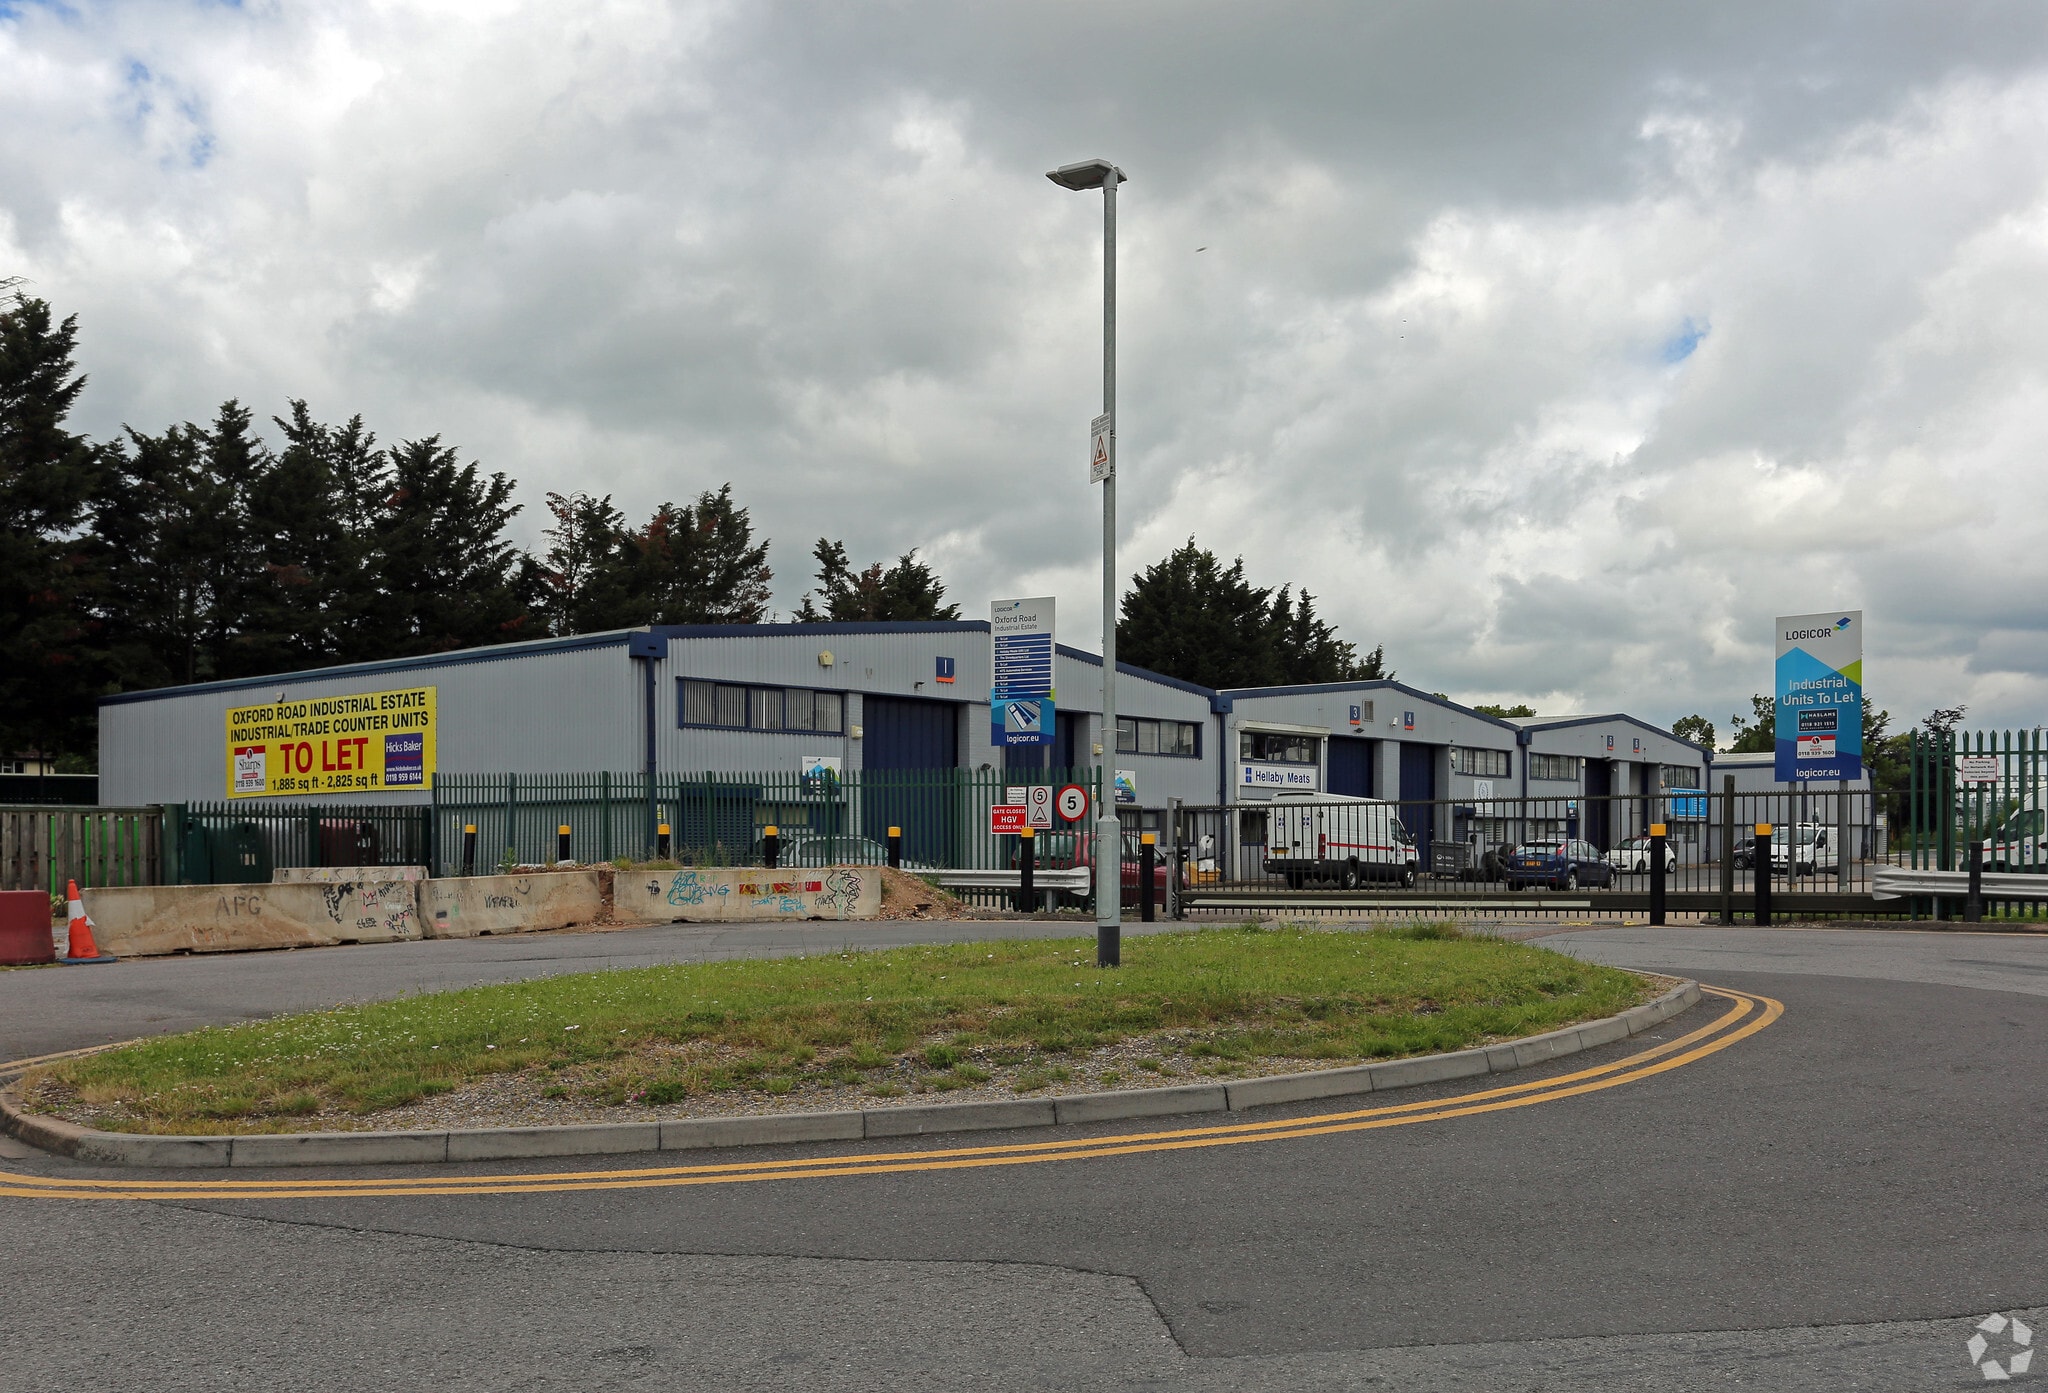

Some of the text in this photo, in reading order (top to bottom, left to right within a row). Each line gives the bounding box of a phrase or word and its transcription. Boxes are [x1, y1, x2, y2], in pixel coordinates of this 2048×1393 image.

[1019, 614, 1036, 622] Road
[1786, 628, 1832, 640] LOGICOR
[1789, 676, 1847, 691] Industrial
[1783, 691, 1854, 706] Units To Let
[233, 692, 425, 724] OXFORD ROAD INDUSTRIAL ESTATE
[1353, 707, 1358, 718] 3
[1408, 713, 1412, 724] 4
[231, 711, 428, 742] INDUSTRIAL/TRADE COUNTER UNITS
[1006, 734, 1040, 744] logicor.eu
[386, 740, 422, 752] Hicks Baker
[280, 737, 368, 774] TO LET
[238, 759, 261, 773] Sharps
[386, 773, 397, 782] 0118
[409, 772, 422, 780] 6144
[1256, 770, 1310, 784] Hellaby Meats
[1796, 768, 1840, 779] logicor.eu
[272, 778, 295, 792] 1,885
[298, 779, 309, 792] sq
[312, 776, 318, 788] ft
[327, 775, 352, 789] 2,825
[356, 776, 367, 789] sq
[371, 773, 378, 786] ft
[1037, 792, 1042, 800] 5
[1068, 796, 1076, 810] 5
